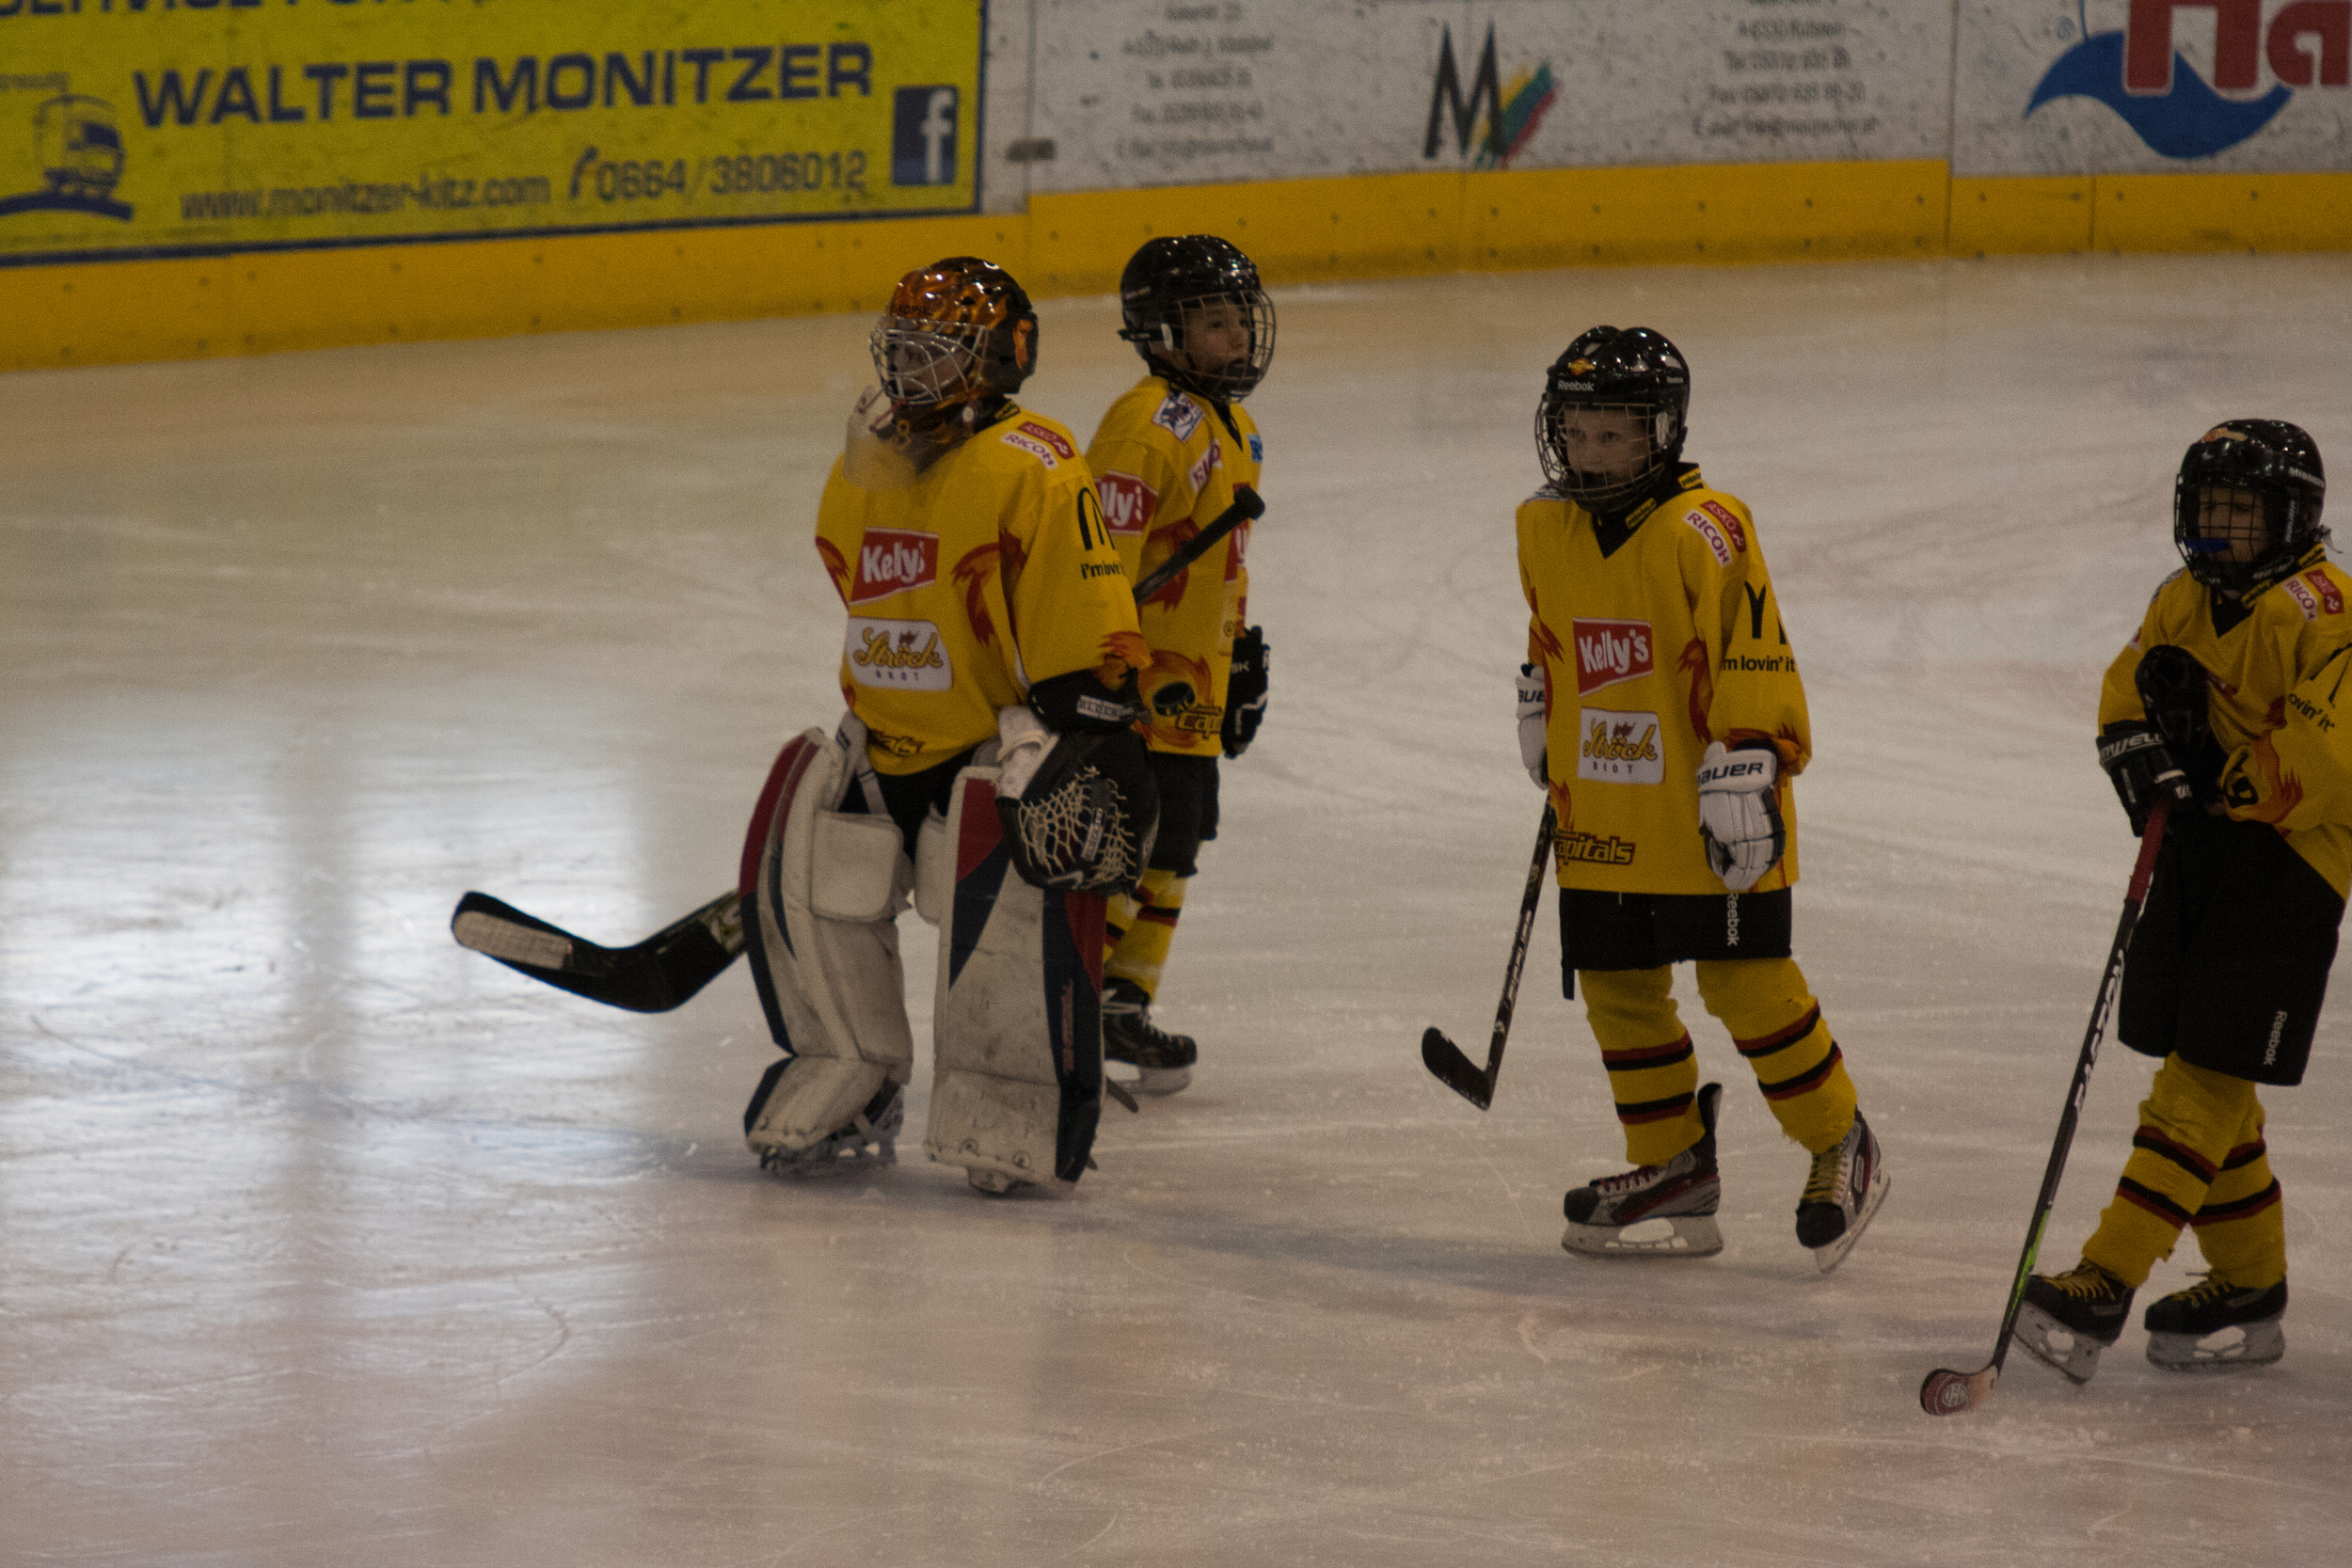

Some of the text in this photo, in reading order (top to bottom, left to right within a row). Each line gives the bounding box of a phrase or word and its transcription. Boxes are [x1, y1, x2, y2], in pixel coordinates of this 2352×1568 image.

[133, 41, 874, 127] WALTER MONITZER
[1557, 379, 1595, 392] Reebok
[1686, 512, 1731, 564] RICOH
[1578, 627, 1650, 675] Kelly's
[2263, 1009, 2289, 1067] Reebok
